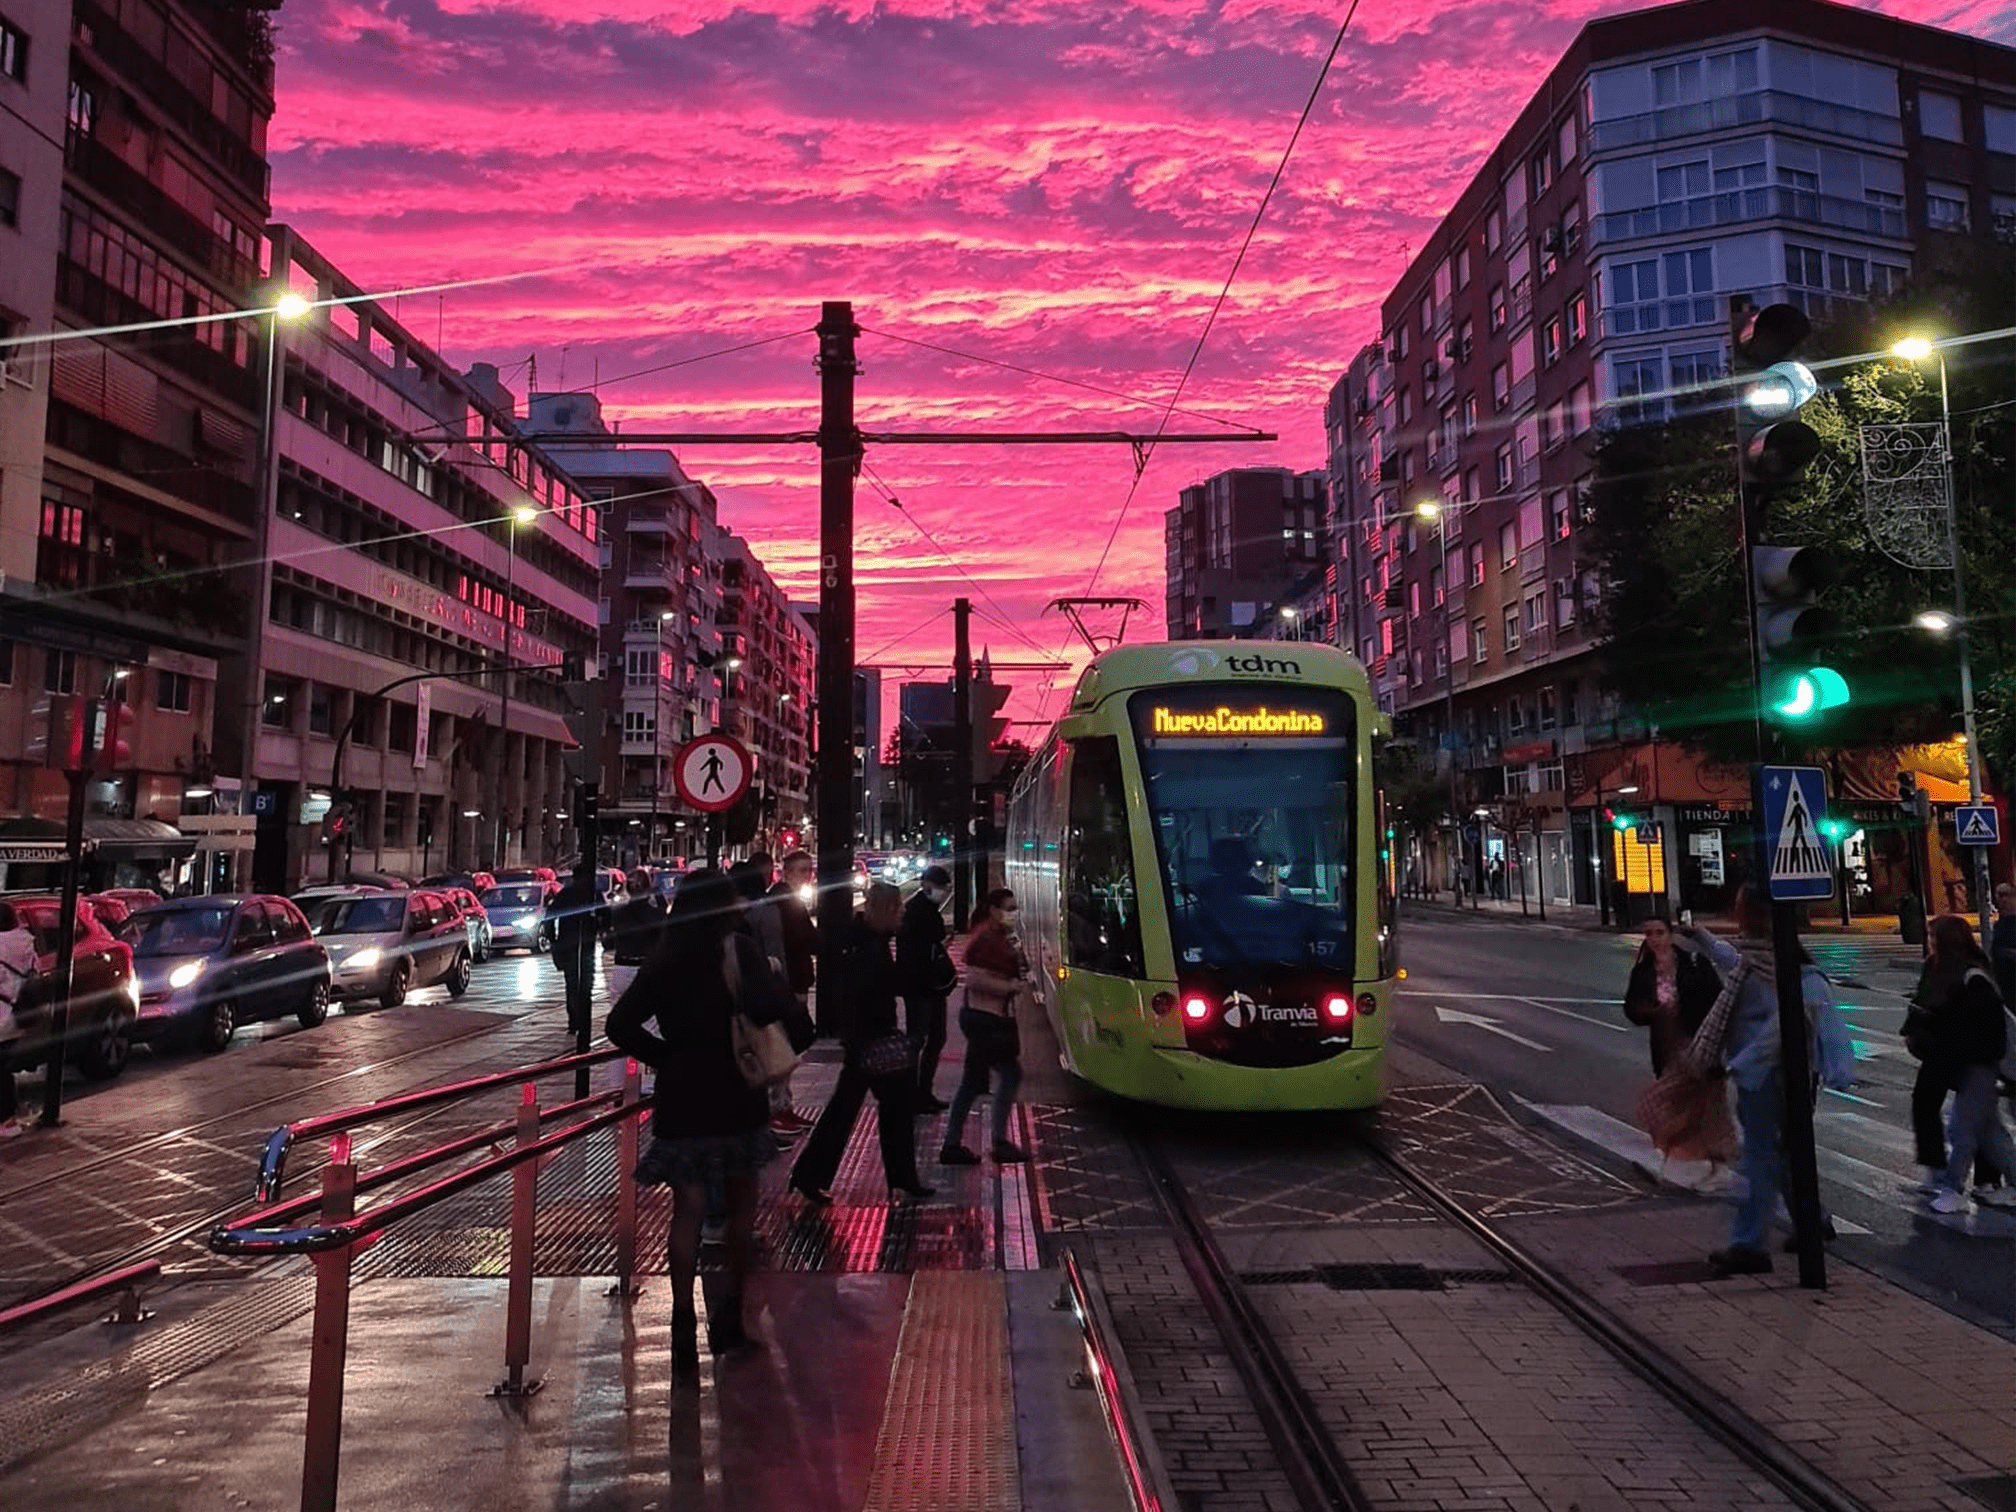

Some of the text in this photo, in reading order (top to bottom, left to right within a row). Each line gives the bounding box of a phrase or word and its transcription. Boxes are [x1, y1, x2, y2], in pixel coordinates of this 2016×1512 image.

[1225, 655, 1301, 674] tdm
[1685, 810, 1731, 821] TIENDA
[1307, 941, 1337, 956] 157
[1258, 1002, 1319, 1021] Tranvía
